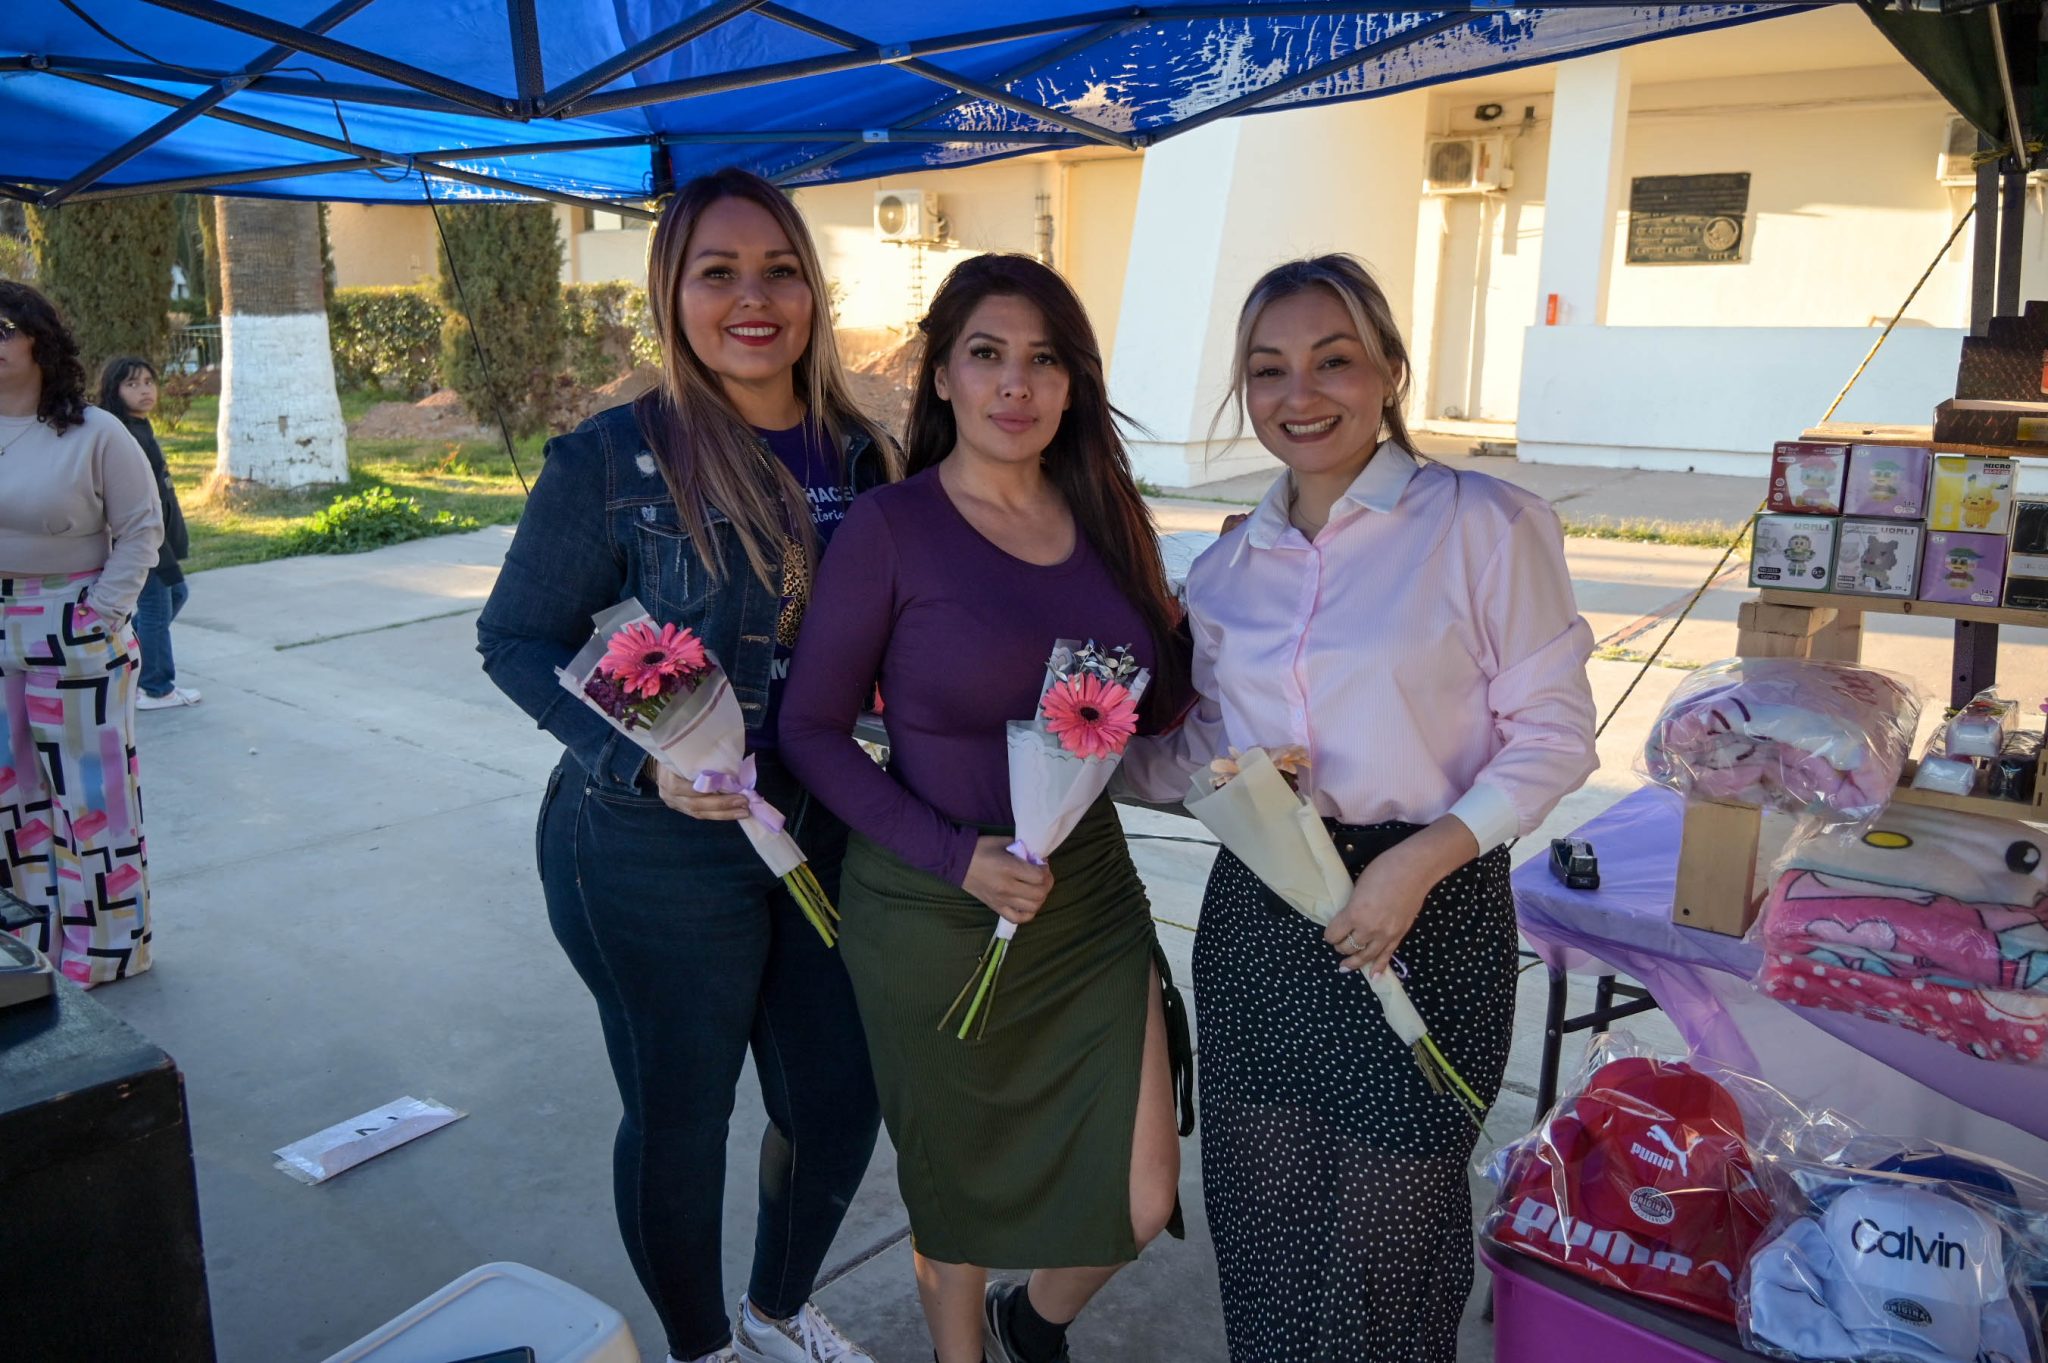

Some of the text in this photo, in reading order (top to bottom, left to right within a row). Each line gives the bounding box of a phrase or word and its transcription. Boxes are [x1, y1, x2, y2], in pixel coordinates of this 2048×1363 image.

[806, 486, 855, 503] HACE
[1631, 1194, 1672, 1219] ORIGINAL
[1851, 1218, 1965, 1270] Calvin
